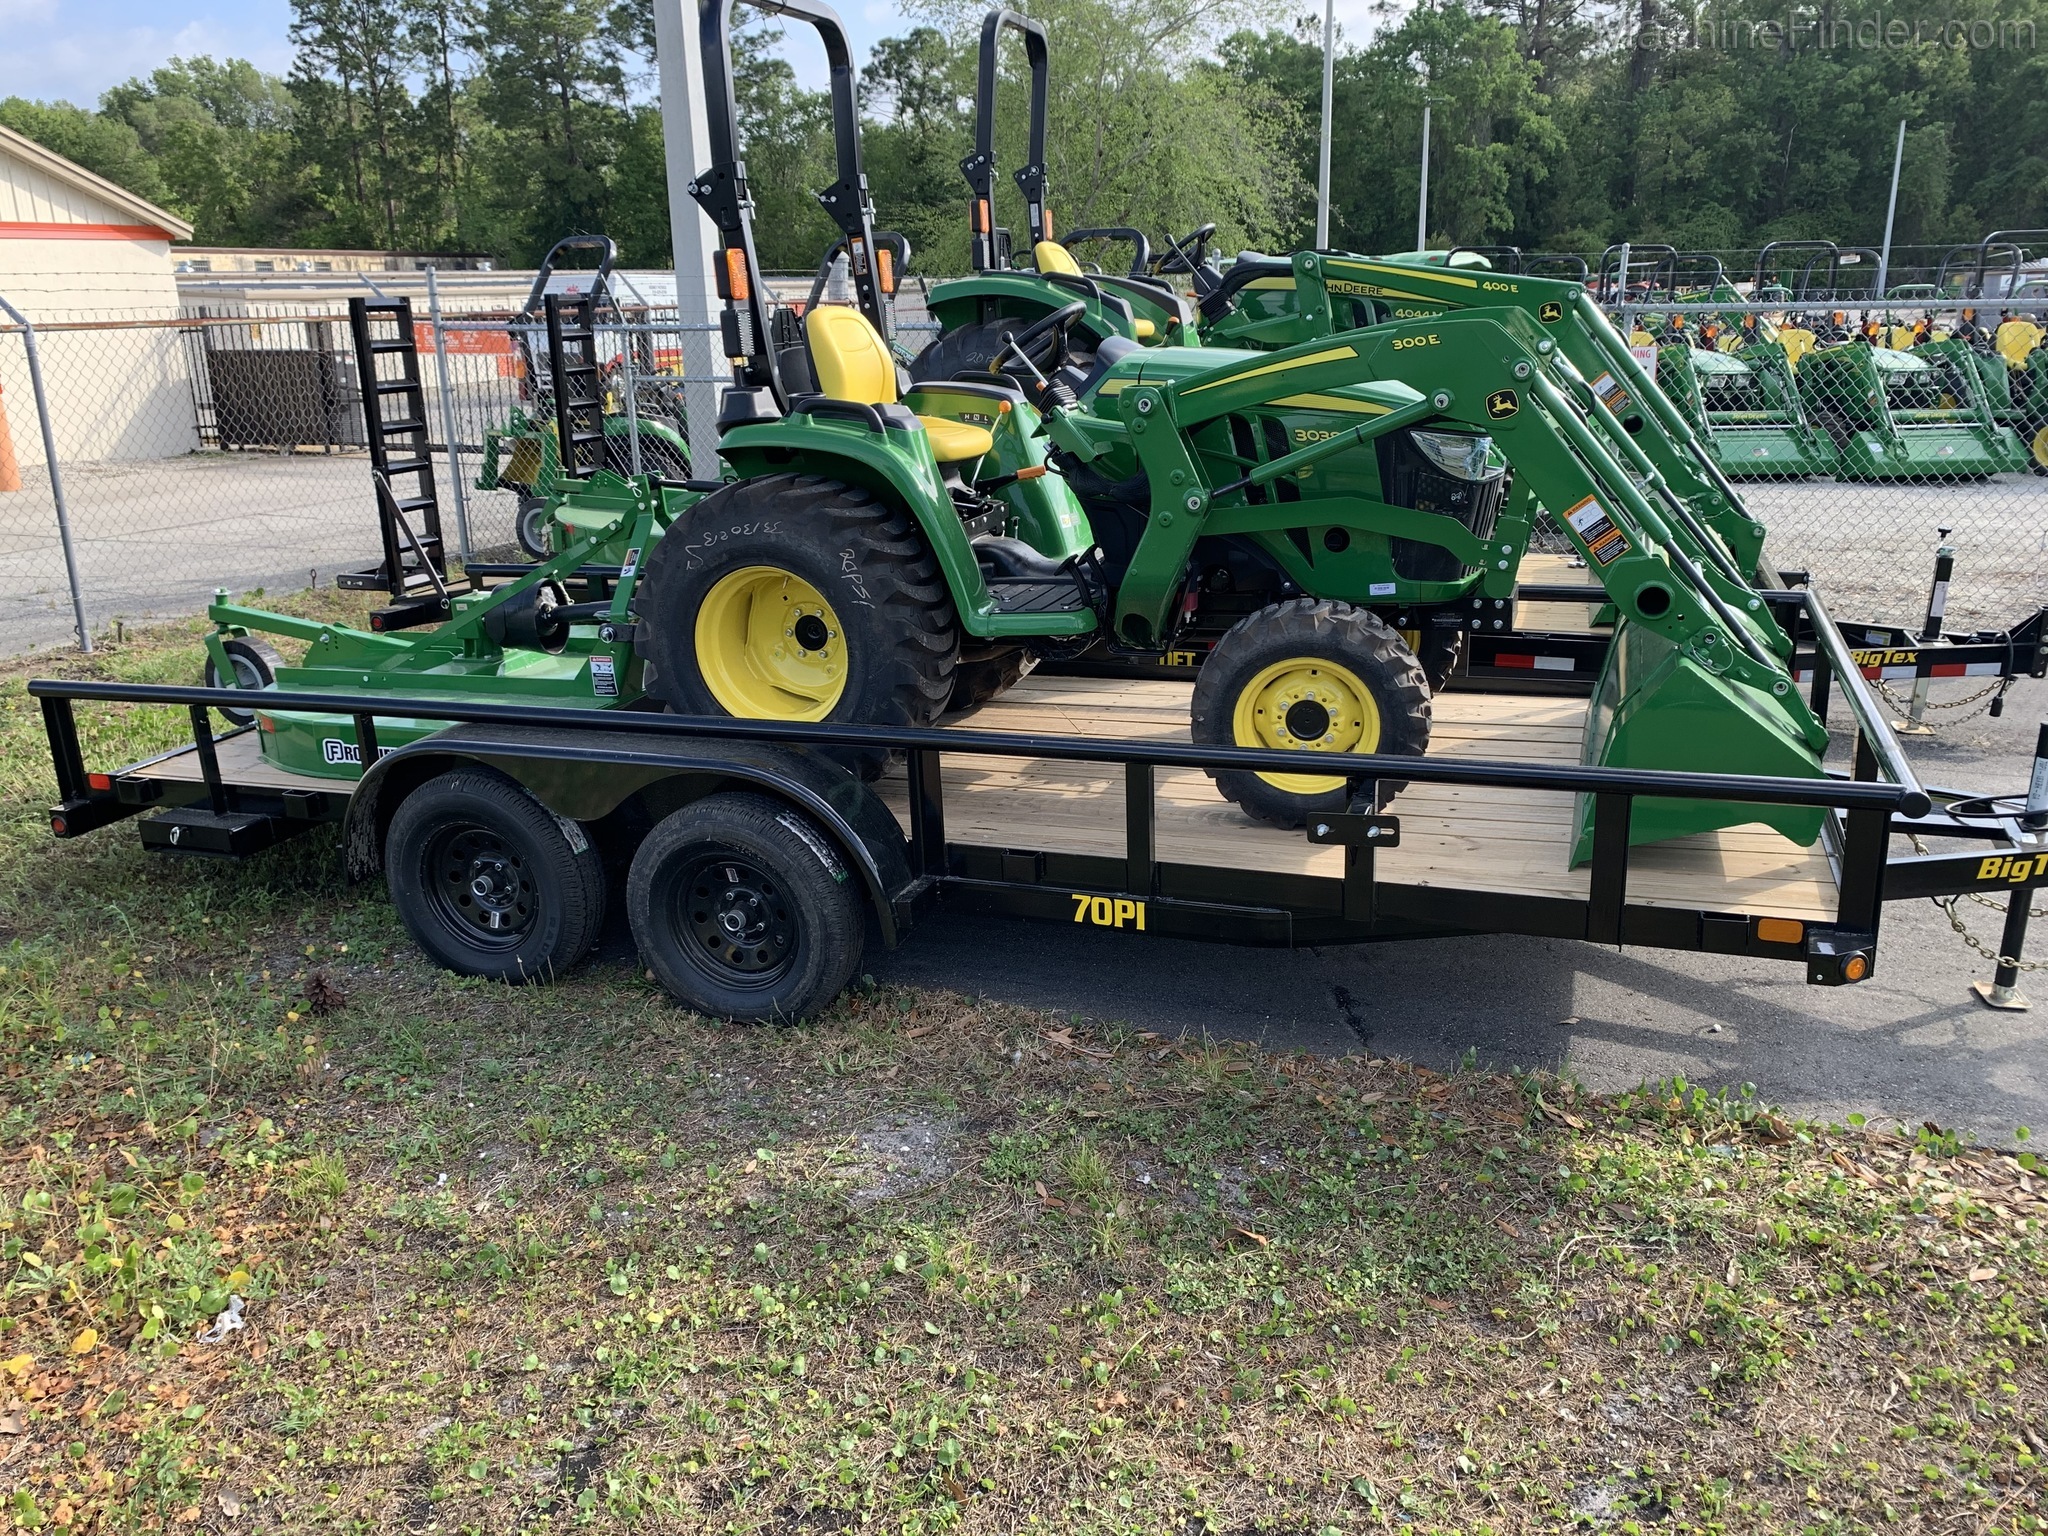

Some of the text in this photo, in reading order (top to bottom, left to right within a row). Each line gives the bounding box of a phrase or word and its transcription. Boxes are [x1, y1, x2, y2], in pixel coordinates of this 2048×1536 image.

[1343, 283, 1384, 296] DEERE
[1976, 853, 2048, 882] BigT
[1071, 893, 1146, 931] 70PI
